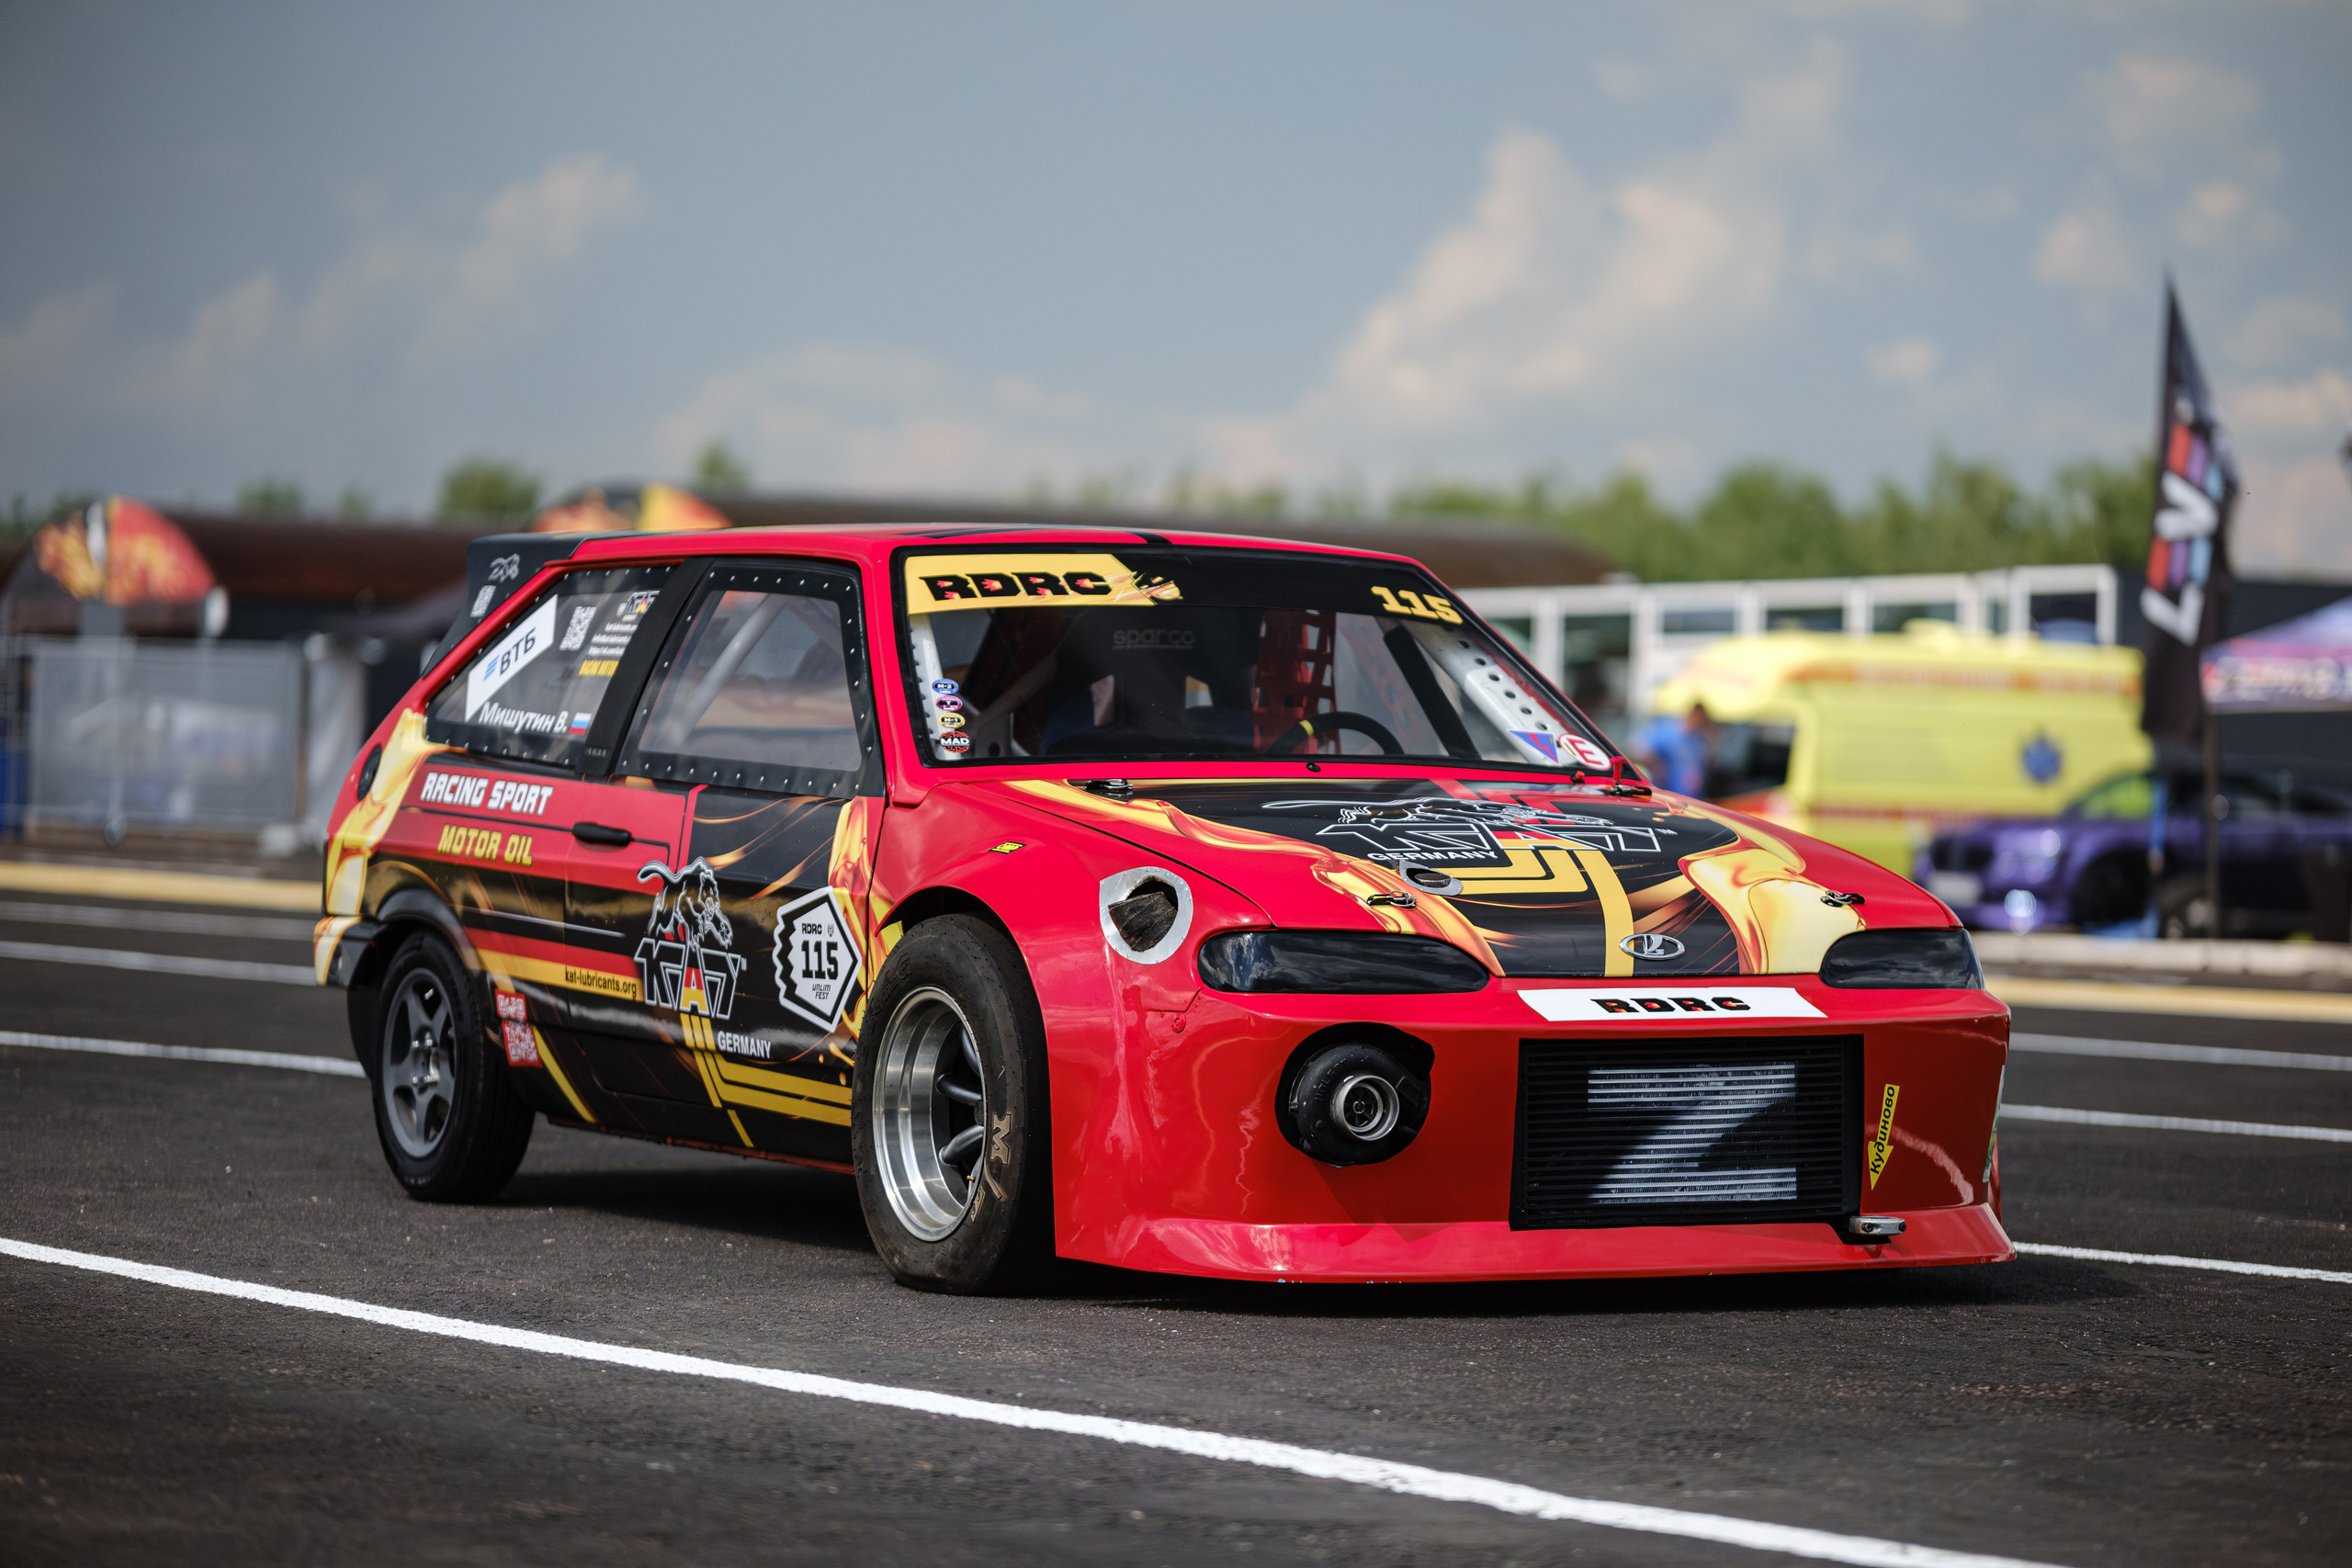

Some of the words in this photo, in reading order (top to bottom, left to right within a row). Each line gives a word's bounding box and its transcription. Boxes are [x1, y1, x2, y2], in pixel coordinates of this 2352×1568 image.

[919, 571, 1113, 601] RDRC
[1371, 585, 1464, 625] 115
[500, 626, 537, 677] ВТБ
[1113, 628, 1194, 647] sparco
[479, 701, 555, 734] Мишутин
[553, 710, 568, 733] В.
[940, 737, 970, 745] MAD
[1566, 738, 1605, 766] E
[420, 772, 489, 807] RACING
[487, 780, 554, 817] SPORT
[437, 824, 503, 862] MOTOR
[503, 833, 534, 867] OIL
[1366, 849, 1498, 862] GERMANY
[801, 922, 822, 935] RDRC
[801, 940, 839, 980] 115
[565, 966, 638, 998] kat-lubricants.org
[634, 936, 742, 1021] KAT
[814, 991, 830, 1000] FEST
[1590, 996, 1752, 1014] RDRC
[718, 1030, 772, 1059] GERMANY
[1870, 1085, 1895, 1176] Кудиново
